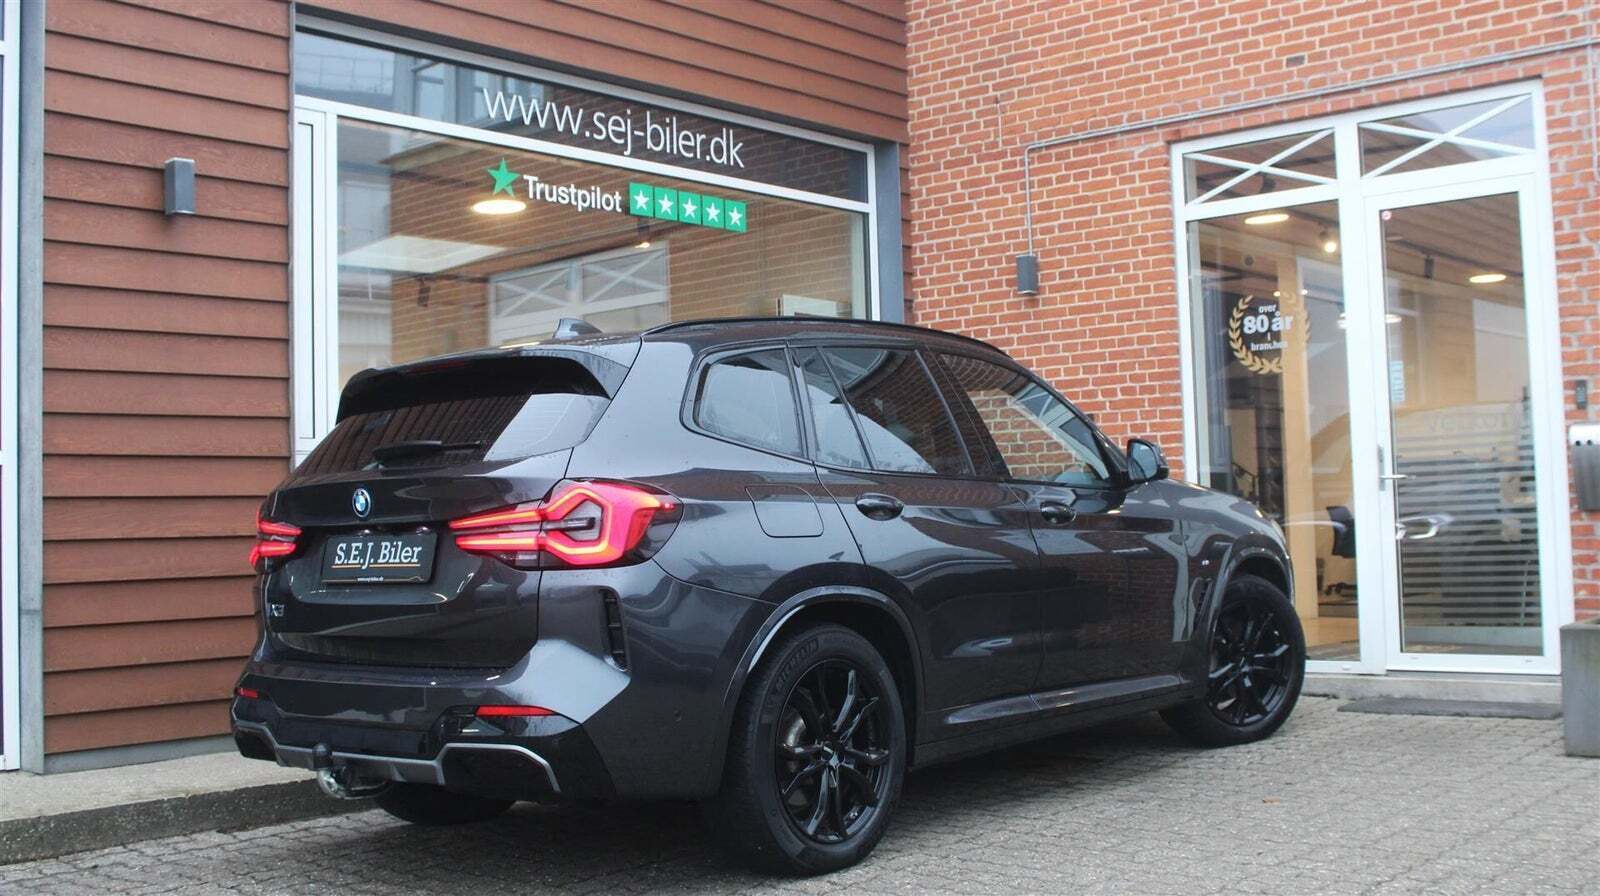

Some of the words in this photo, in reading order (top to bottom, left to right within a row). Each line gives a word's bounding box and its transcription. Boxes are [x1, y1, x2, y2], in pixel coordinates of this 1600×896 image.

[483, 88, 744, 168] www.sej-biler.dk
[523, 174, 622, 213] Trustpilot
[1243, 314, 1269, 334] 80
[1271, 311, 1294, 331] år
[1258, 304, 1276, 313] over
[334, 542, 374, 569] S.E.J.
[377, 541, 421, 563] Biler
